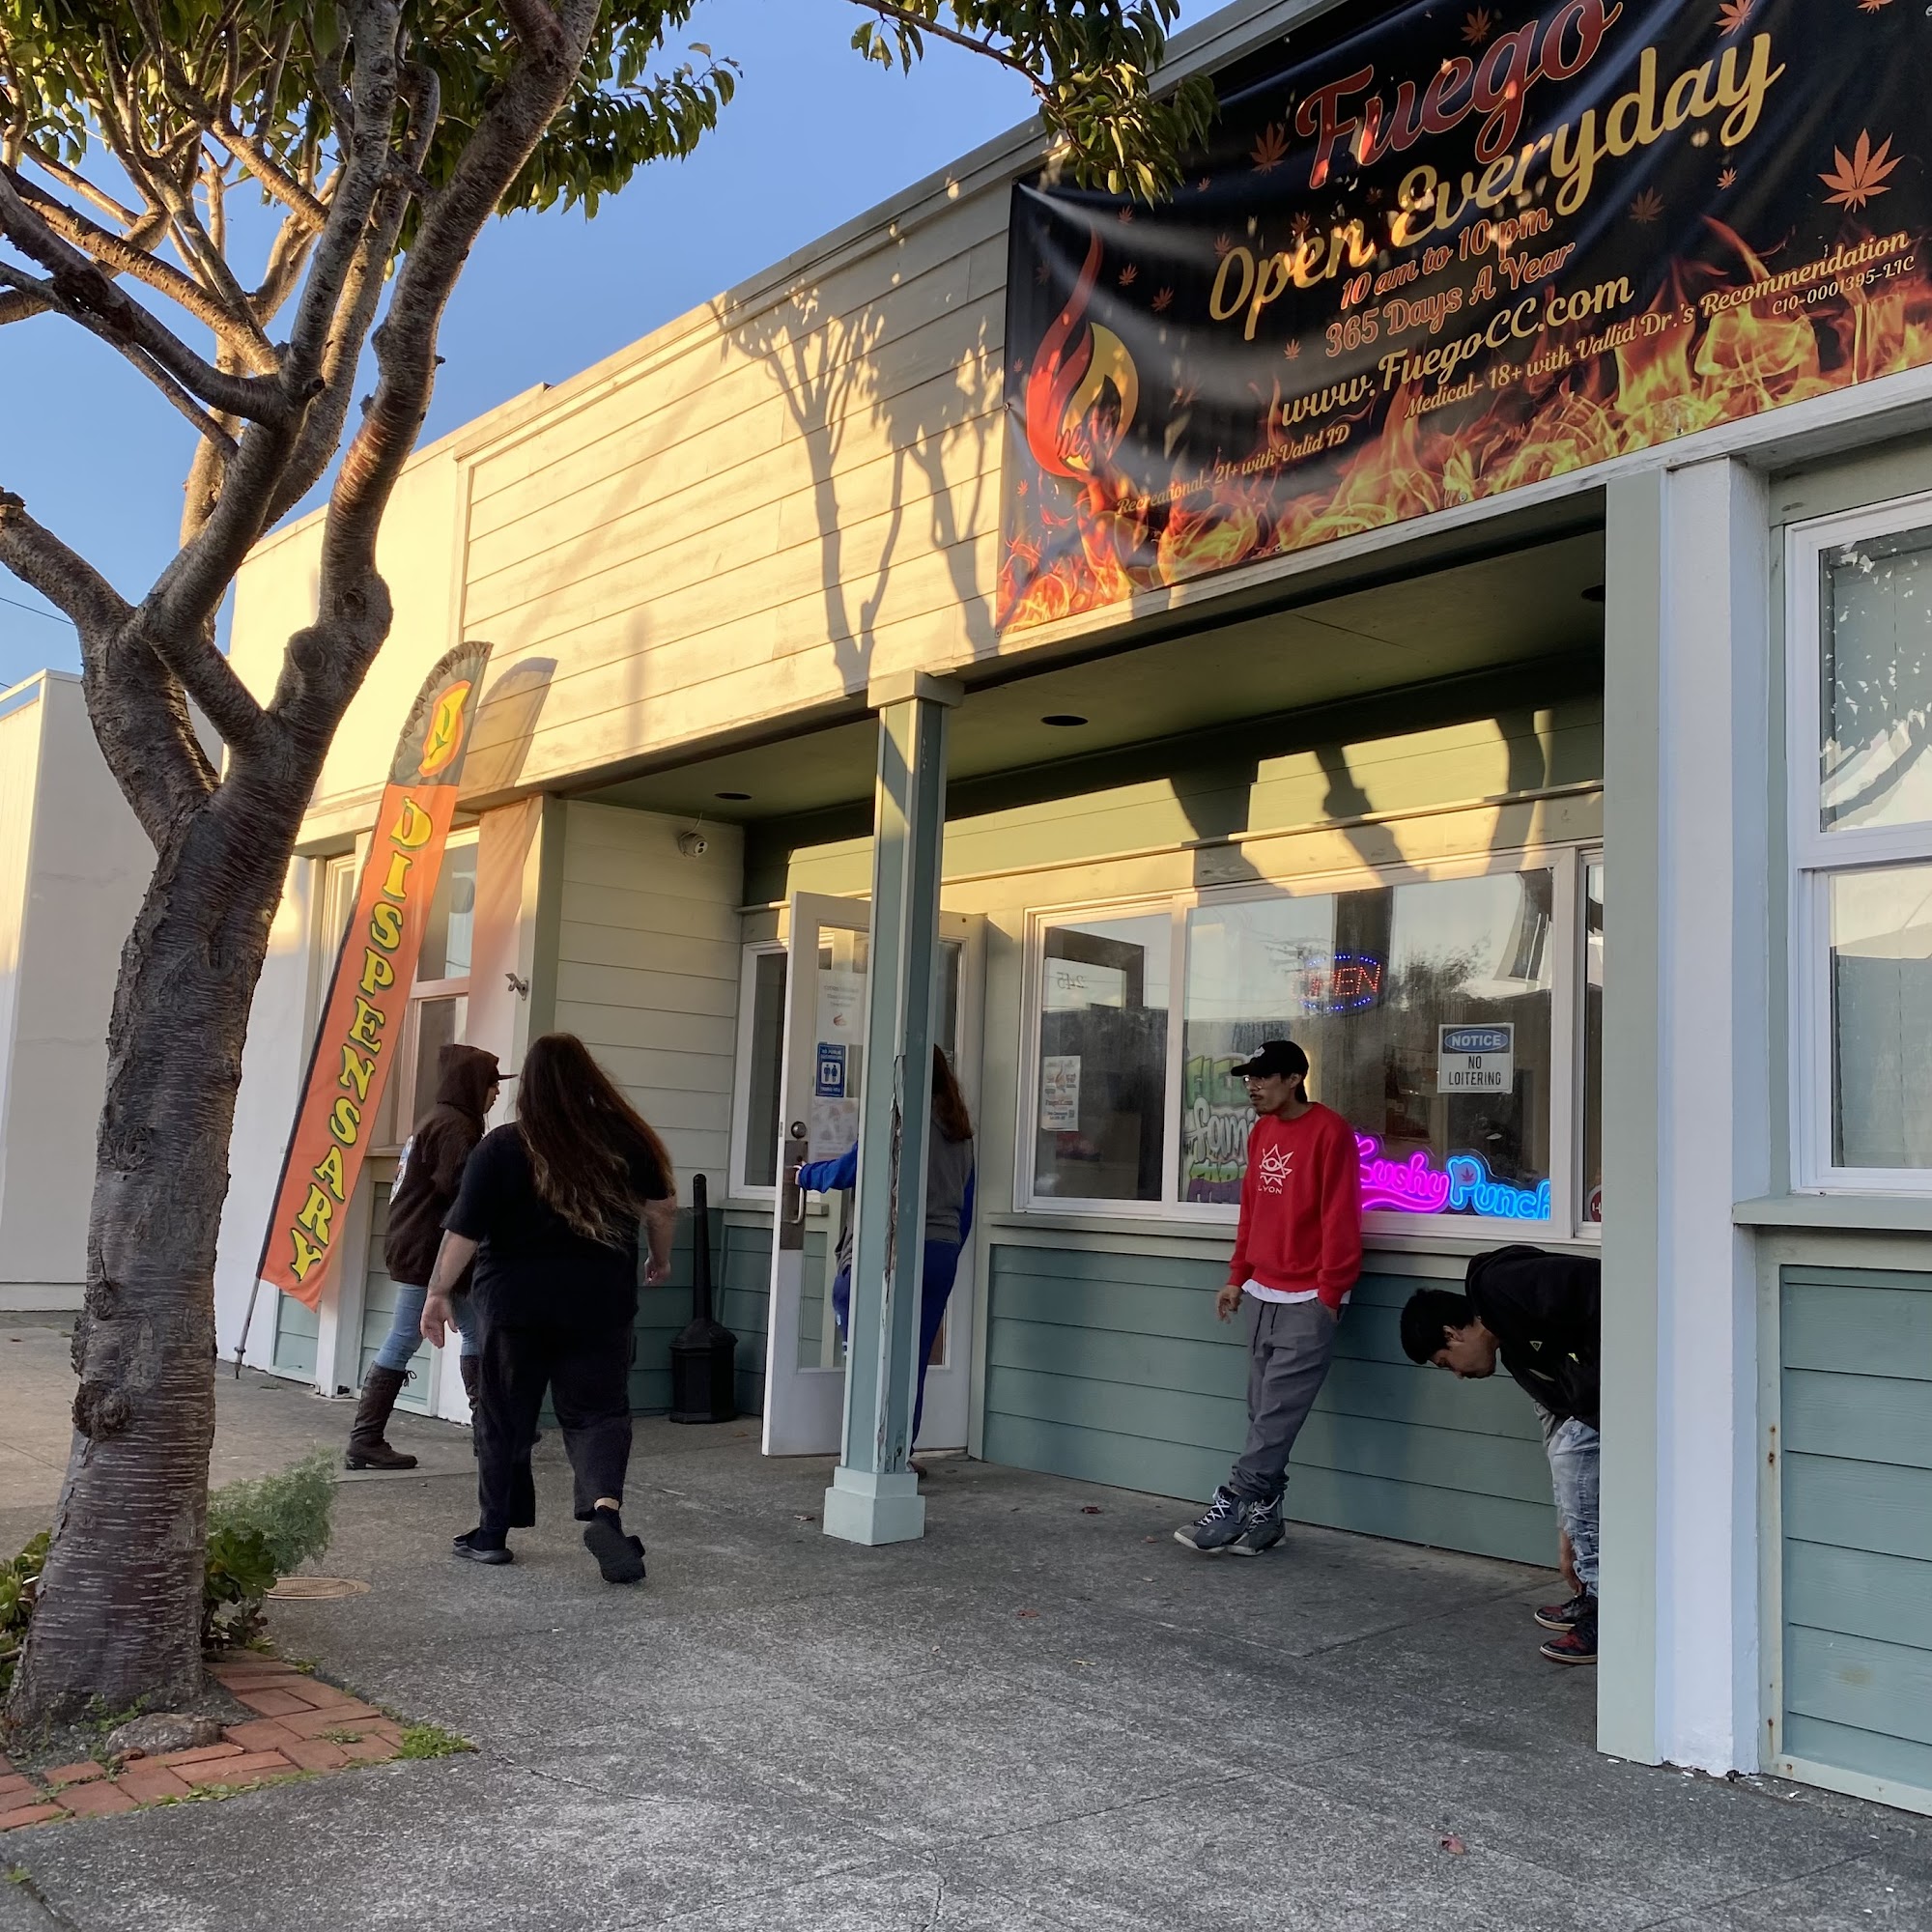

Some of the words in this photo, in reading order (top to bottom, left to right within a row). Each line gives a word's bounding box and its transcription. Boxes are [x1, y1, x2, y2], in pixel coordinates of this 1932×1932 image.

[1295, 0, 1624, 190] Fuego
[1209, 219, 1376, 341] Open
[1391, 33, 1786, 247] Everyday
[1324, 306, 1380, 357] 365
[1382, 286, 1463, 334] Days
[1468, 265, 1497, 307] A
[1498, 242, 1577, 291] Year
[1340, 271, 1372, 310] 10
[1373, 261, 1418, 297] am
[1421, 246, 1455, 277] to
[1459, 219, 1492, 261] 10
[1496, 207, 1554, 263] pm
[1772, 256, 1916, 316] C10-0001395-LIC
[1404, 373, 1484, 419] Medical-
[1489, 364, 1522, 390] 18+
[1526, 344, 1572, 378] with
[1640, 302, 1695, 338] Dr.'s
[1700, 232, 1910, 317] Recommendation
[1117, 468, 1210, 515] Recreational-
[1214, 462, 1239, 485] 21+
[1241, 448, 1277, 475] with
[1279, 430, 1324, 463] Valid
[1325, 423, 1351, 448] ID
[1291, 964, 1381, 999] OPEN
[290, 794, 434, 1283] DISPENSARY
[1449, 1071, 1501, 1086] LOITERING
[1451, 1035, 1502, 1047] NOTICE
[1468, 1055, 1482, 1069] NO
[1258, 1185, 1283, 1195] LYON
